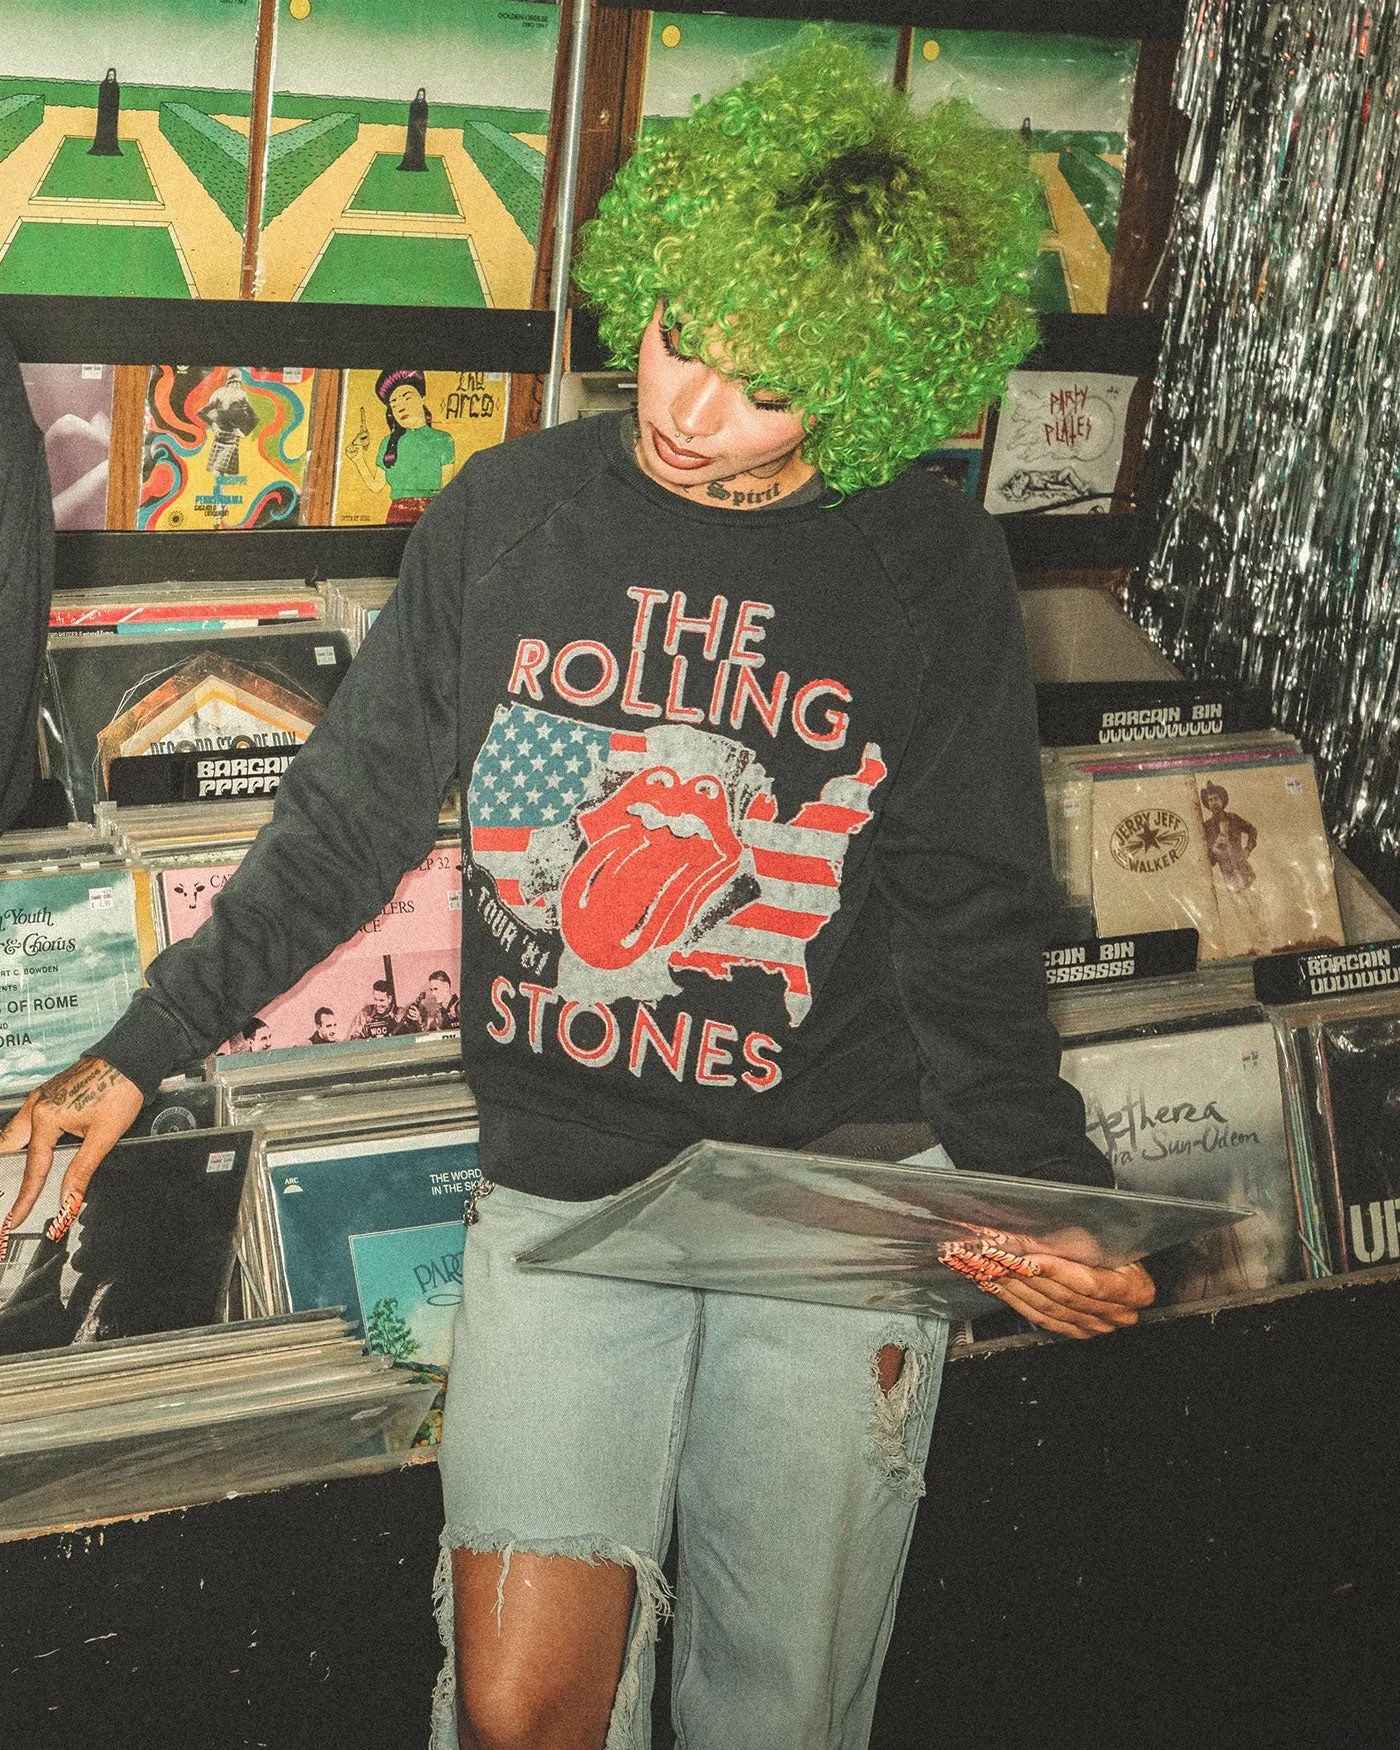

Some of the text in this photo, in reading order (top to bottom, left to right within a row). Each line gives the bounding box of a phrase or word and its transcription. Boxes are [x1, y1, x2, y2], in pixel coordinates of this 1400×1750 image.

[1050, 384, 1089, 416] PARTY
[1044, 415, 1092, 447] PLATES
[707, 482, 780, 506] Spirit
[627, 585, 776, 668] THE
[507, 638, 854, 751] ROLLING
[1102, 703, 1223, 727] BARGAIN BIN
[1115, 811, 1182, 846] JERRY JEFF
[437, 857, 450, 870] 32
[1128, 848, 1180, 873] WALKER
[4, 906, 54, 927] Youth
[381, 900, 415, 915] LERS
[477, 886, 518, 952] TOUR
[4, 932, 76, 957] & Chorus
[1099, 941, 1135, 961] BIN
[24, 965, 59, 975] BOWDEN
[1307, 948, 1391, 977] BARGAIN
[0, 984, 18, 992] NTS
[7, 994, 79, 1013] OF ROME
[486, 975, 784, 1094] STONES
[284, 1177, 300, 1185] ARC
[429, 1168, 482, 1184] THE WORD
[431, 1180, 480, 1196] IN THE SK
